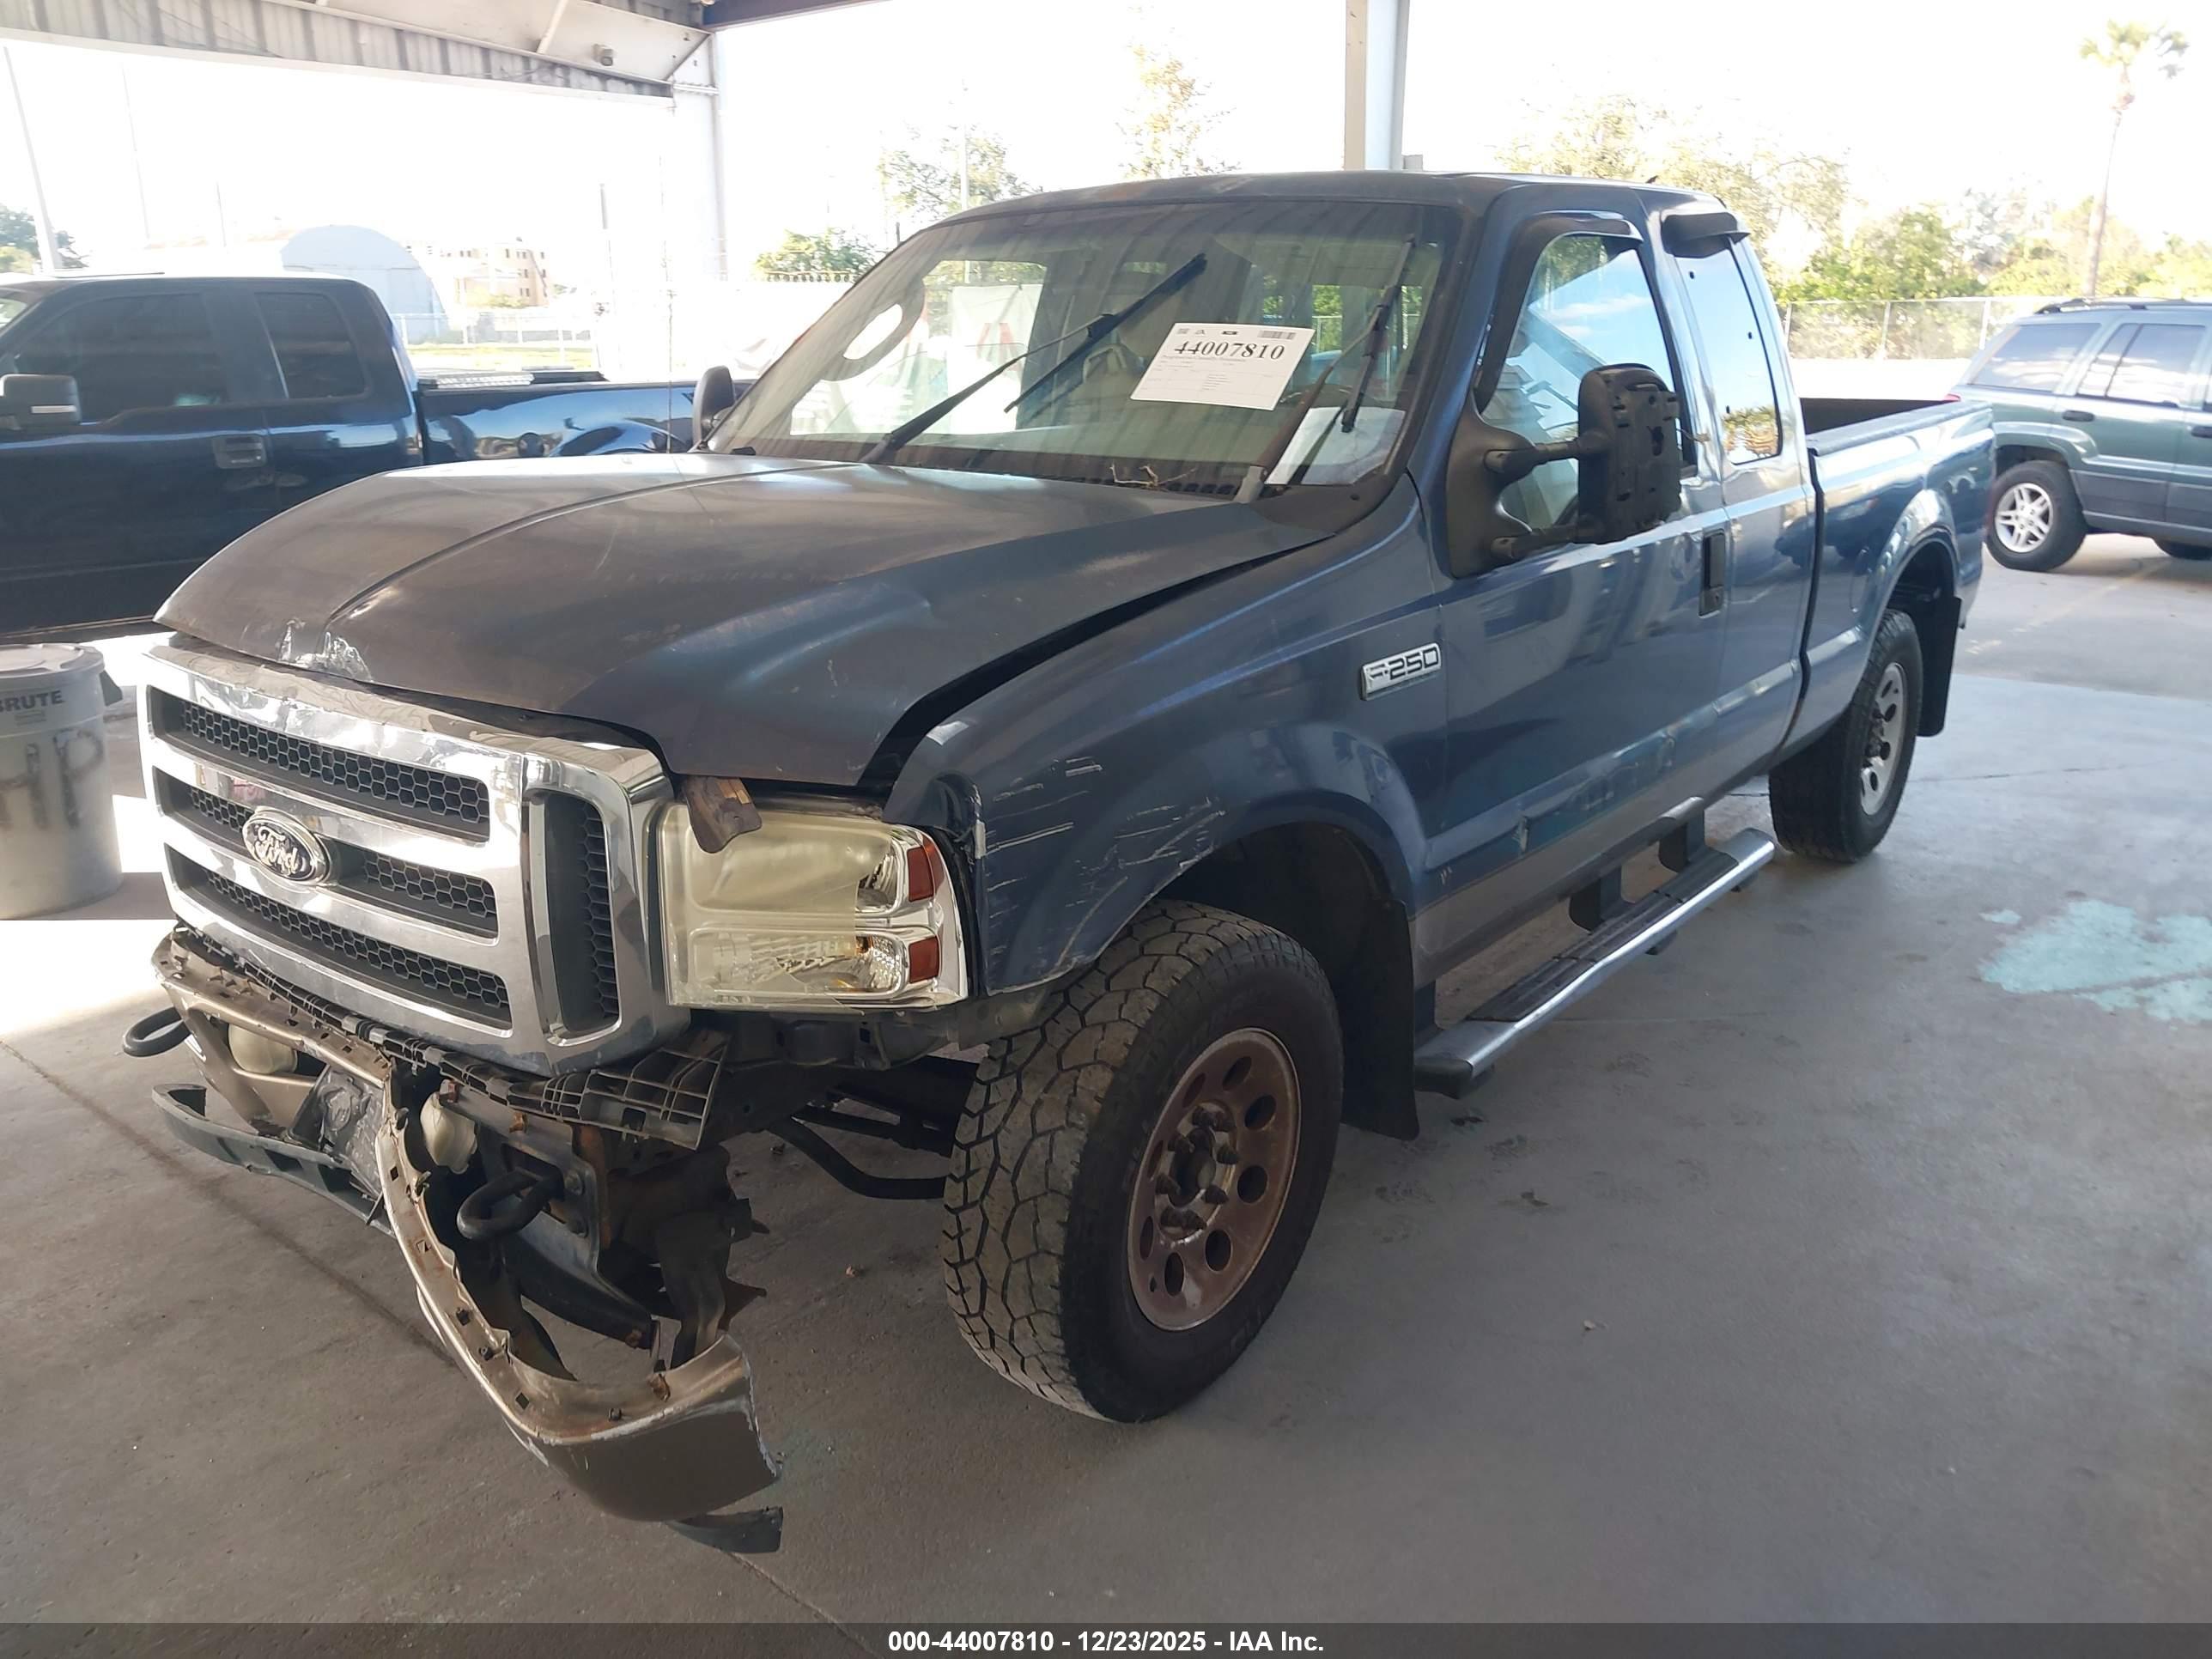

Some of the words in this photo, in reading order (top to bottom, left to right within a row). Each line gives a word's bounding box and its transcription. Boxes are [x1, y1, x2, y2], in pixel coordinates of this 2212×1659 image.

[1174, 340, 1285, 361] 44007810
[1366, 646, 1439, 691] F-250
[253, 824, 301, 876] Ford
